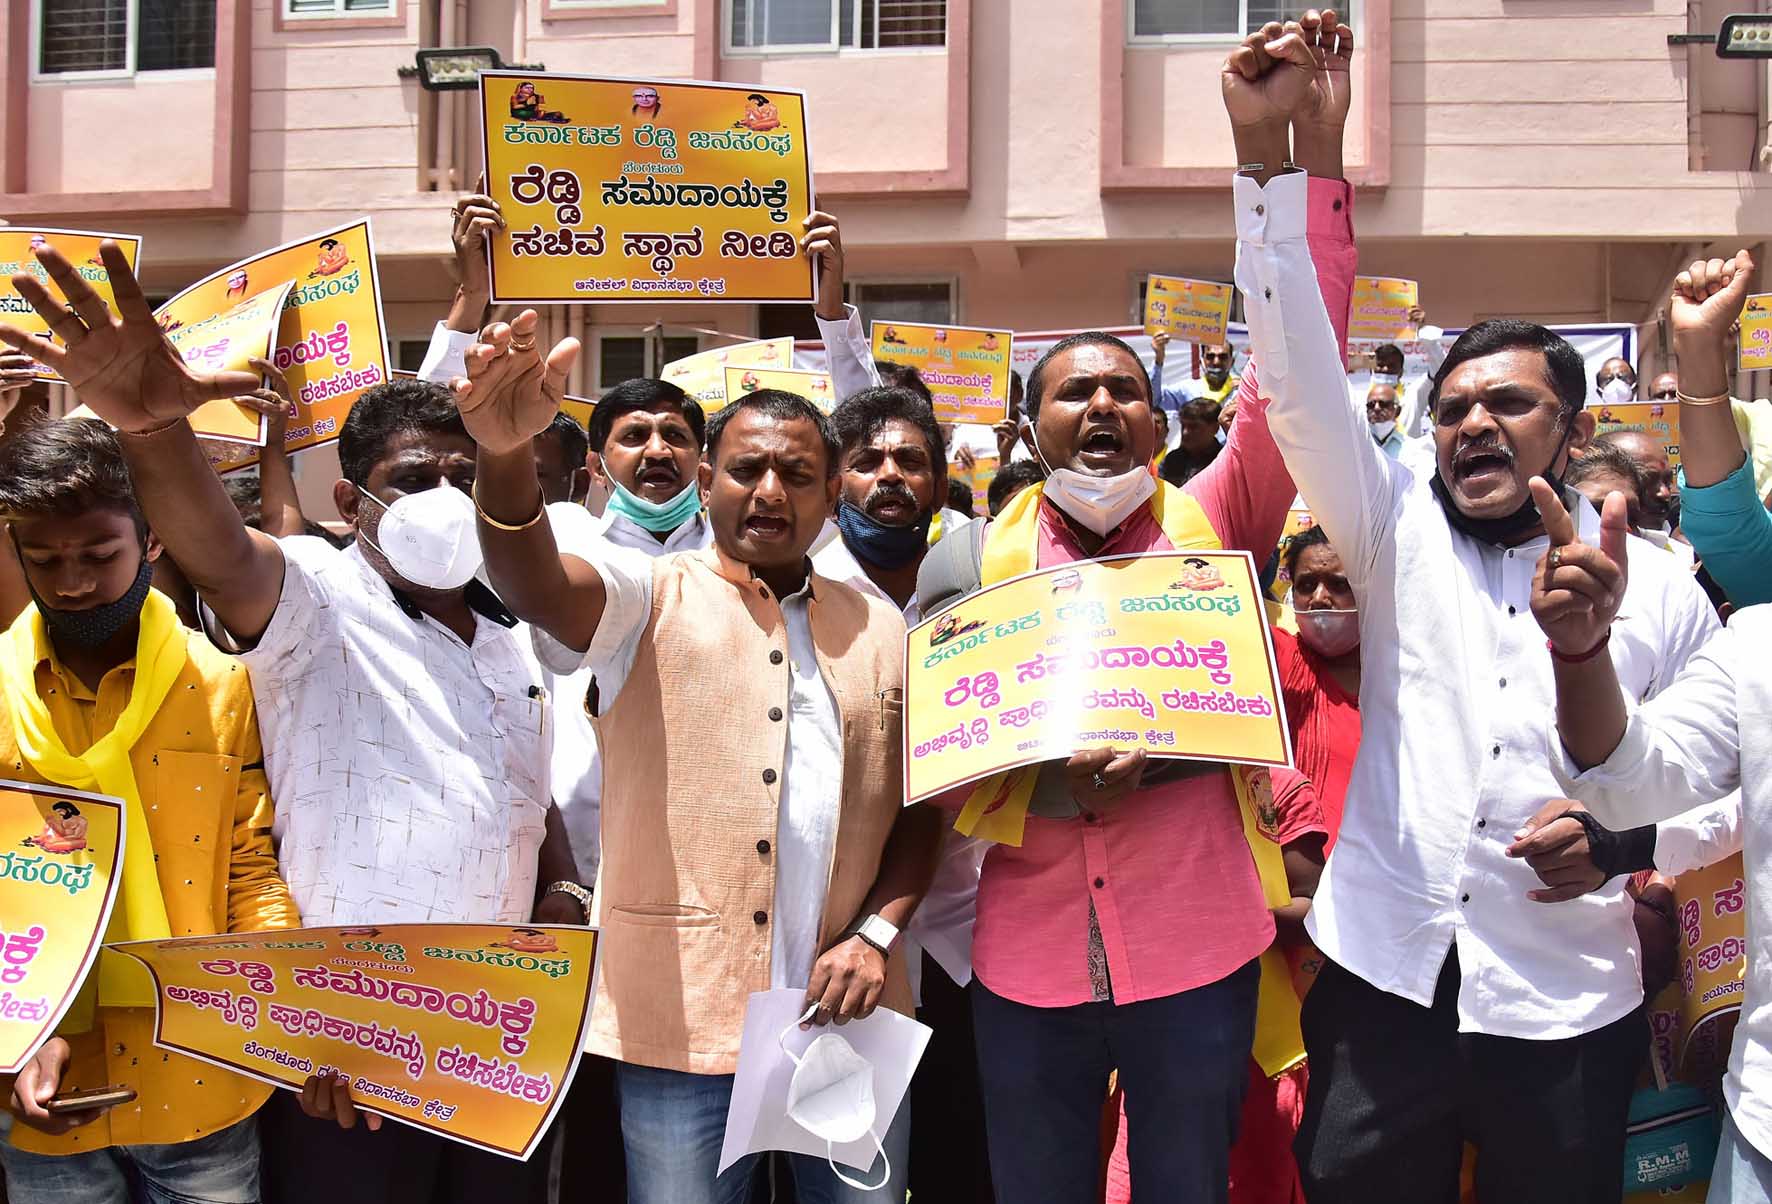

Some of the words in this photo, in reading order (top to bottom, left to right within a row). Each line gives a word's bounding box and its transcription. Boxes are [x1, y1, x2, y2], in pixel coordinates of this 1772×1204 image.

[503, 122, 622, 146] ಕರ್ನಾಟಕ
[634, 127, 678, 159] ರೆಡ್ಡಿ
[689, 129, 792, 156] ಜನಸಂಘ
[622, 161, 684, 175] ಬೆಂಗಳೂರು
[510, 164, 582, 226] ರೆಡ್ಡಿ
[601, 175, 789, 223] ಸಮುದಾಯಕ್ಕೆ
[511, 225, 606, 258] ಸಚಿವ
[623, 226, 703, 276] ಸ್ಥಾನ
[721, 230, 797, 258] ನೀಡಿ
[631, 279, 693, 292] ವಿಧಾನಸಭಾ
[698, 280, 726, 296] ಕ್ಷೇತ್ರ
[300, 363, 382, 405] ರಚಿಸಬೇಕು
[923, 610, 1042, 669] ಕರ್ನಾಟಕ
[1120, 593, 1241, 617] ಜನಸಂಘ
[944, 671, 1001, 709] ರೆಡ್ಡಿ
[913, 716, 990, 759] ಅಭಿವೃದ್ಧಿ
[1162, 688, 1273, 717] ರಚಿಸಬೇಕು
[422, 945, 572, 978] ಜನಸಂಘ
[201, 959, 275, 994] ರೆಡ್ಡಿ
[294, 965, 536, 1055] ಸಮುದಾಯಕ್ಕೆ
[166, 985, 259, 1030] ಅಭಿವೃದ್ಧಿ
[269, 1003, 426, 1080] ಪ್ರಾಧಿಕಾರವನ್ನು
[436, 1046, 553, 1104] ರಚಿಸಬೇಕು
[243, 1041, 313, 1074] ಬೆಂಗಳೂರು
[353, 1077, 421, 1108] ವಿಧಾನಸಭಾ
[423, 1098, 458, 1122] ಕ್ಷೇತ್ರ
